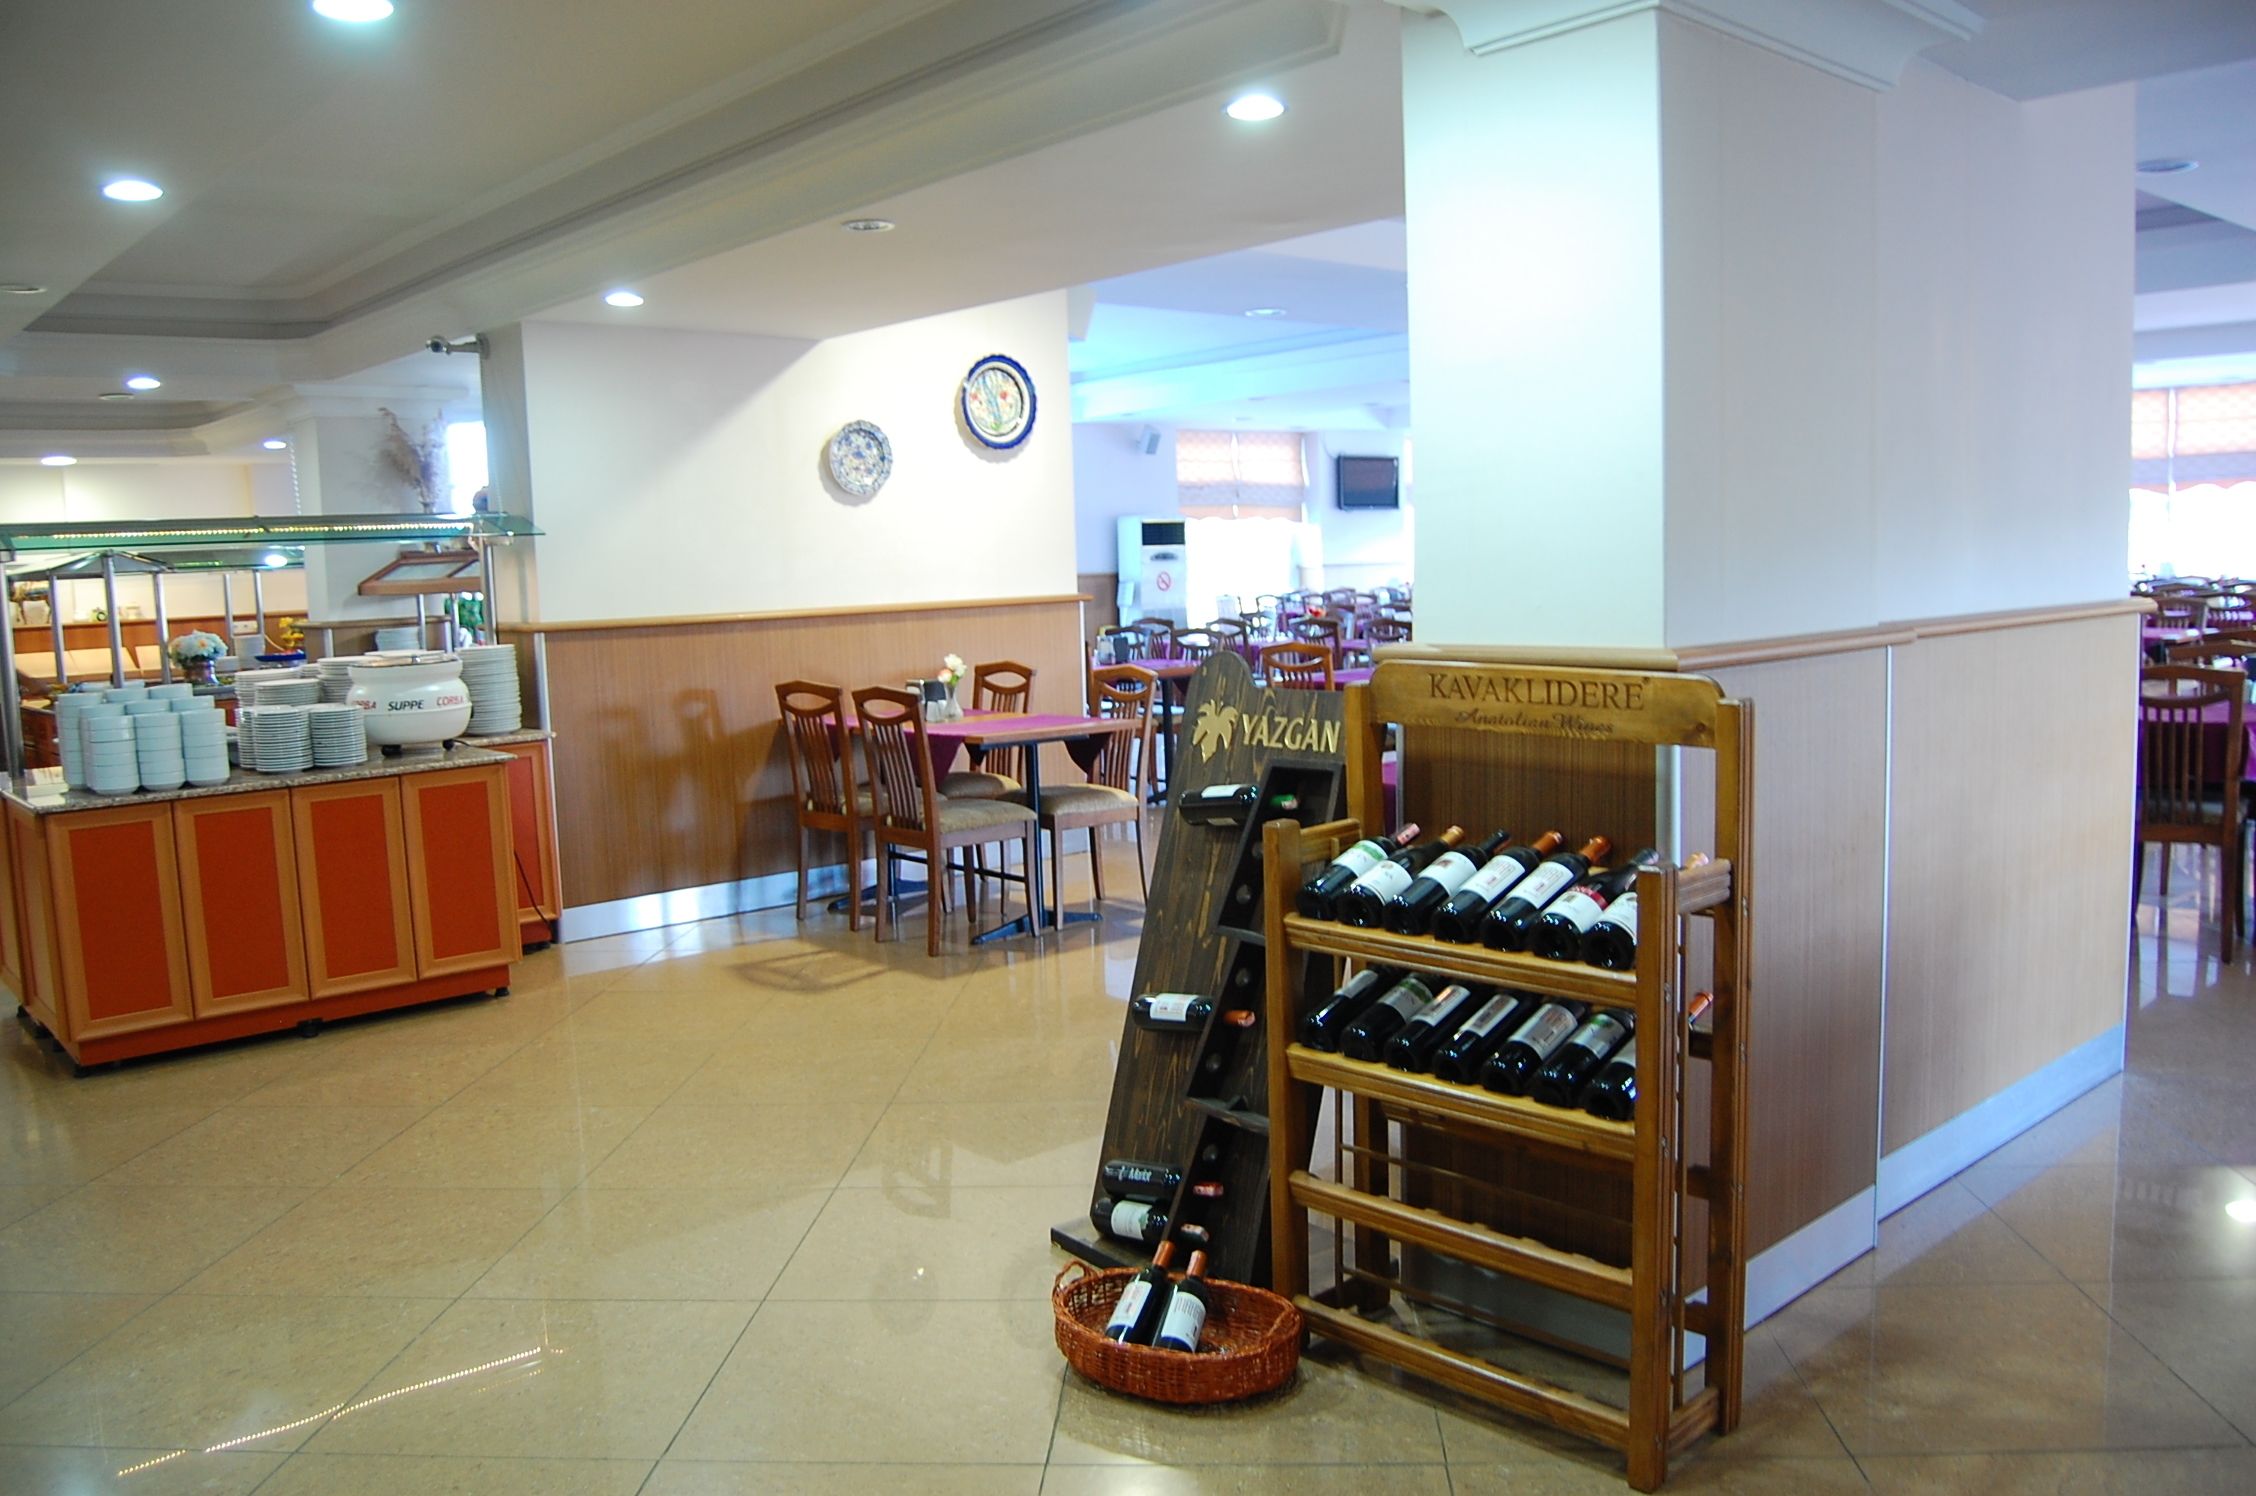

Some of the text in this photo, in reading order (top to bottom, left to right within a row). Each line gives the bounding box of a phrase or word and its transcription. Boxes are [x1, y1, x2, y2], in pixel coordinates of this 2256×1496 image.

[388, 699, 424, 711] SUPPE
[1429, 672, 1645, 711] KAVAKLIDERE
[1242, 713, 1341, 754] YAZGAN
[1455, 708, 1615, 733] Anatolian Wines
